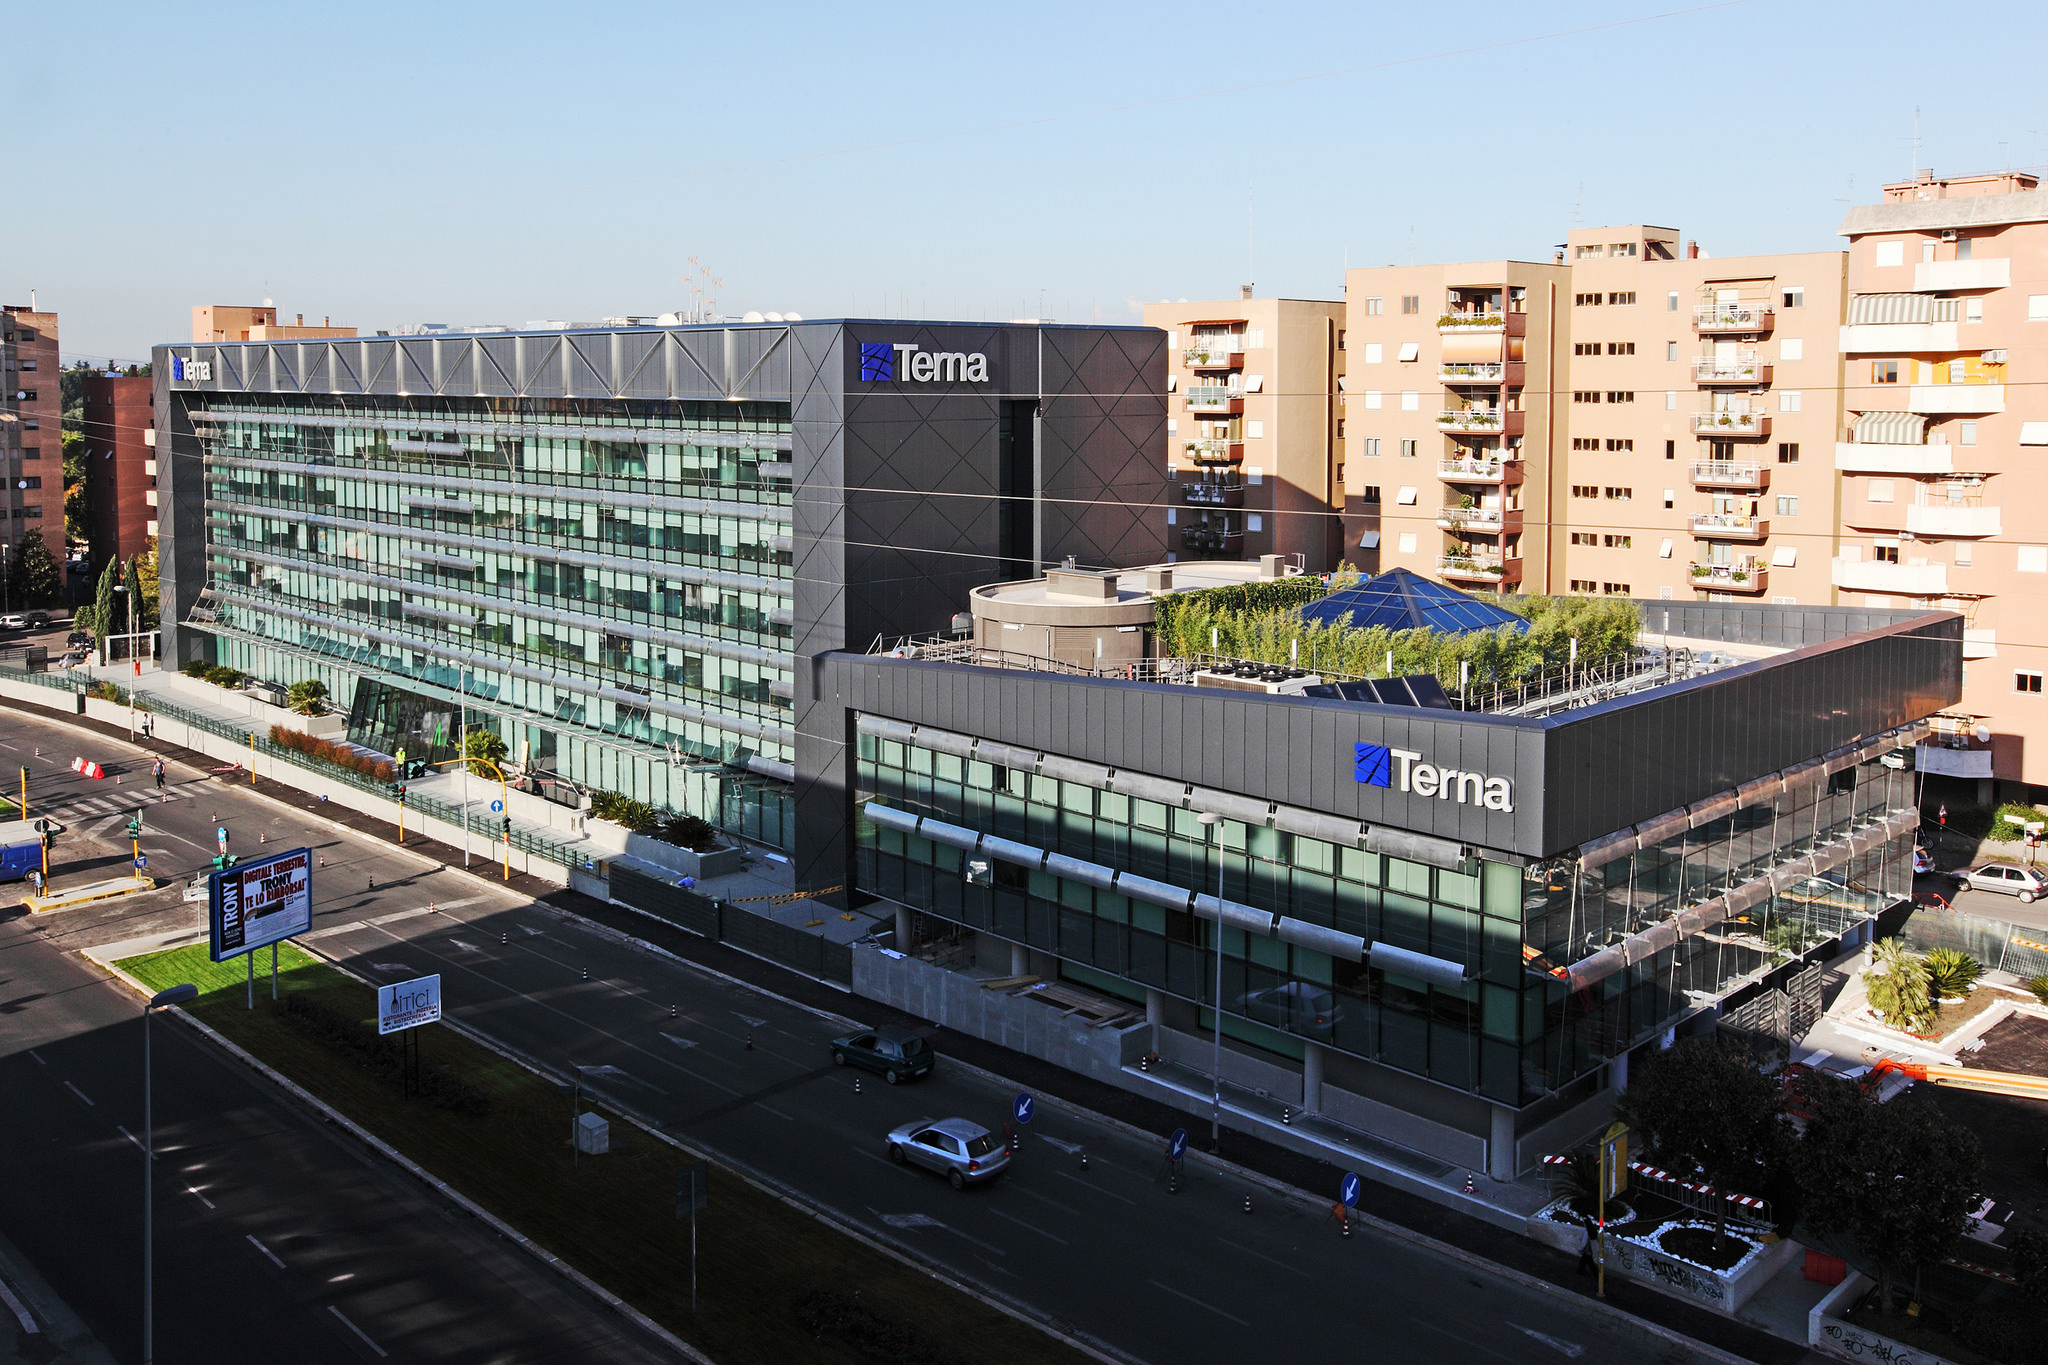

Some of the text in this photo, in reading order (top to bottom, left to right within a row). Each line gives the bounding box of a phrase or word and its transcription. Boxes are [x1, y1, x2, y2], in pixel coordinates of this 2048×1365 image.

[181, 357, 212, 381] Terna
[893, 343, 989, 382] Terna
[1390, 748, 1515, 813] Terna
[244, 864, 272, 885] DIGITALE
[260, 871, 293, 892] TRONY
[223, 882, 238, 931] TRONY
[245, 895, 254, 909] TE
[255, 892, 265, 906] LO
